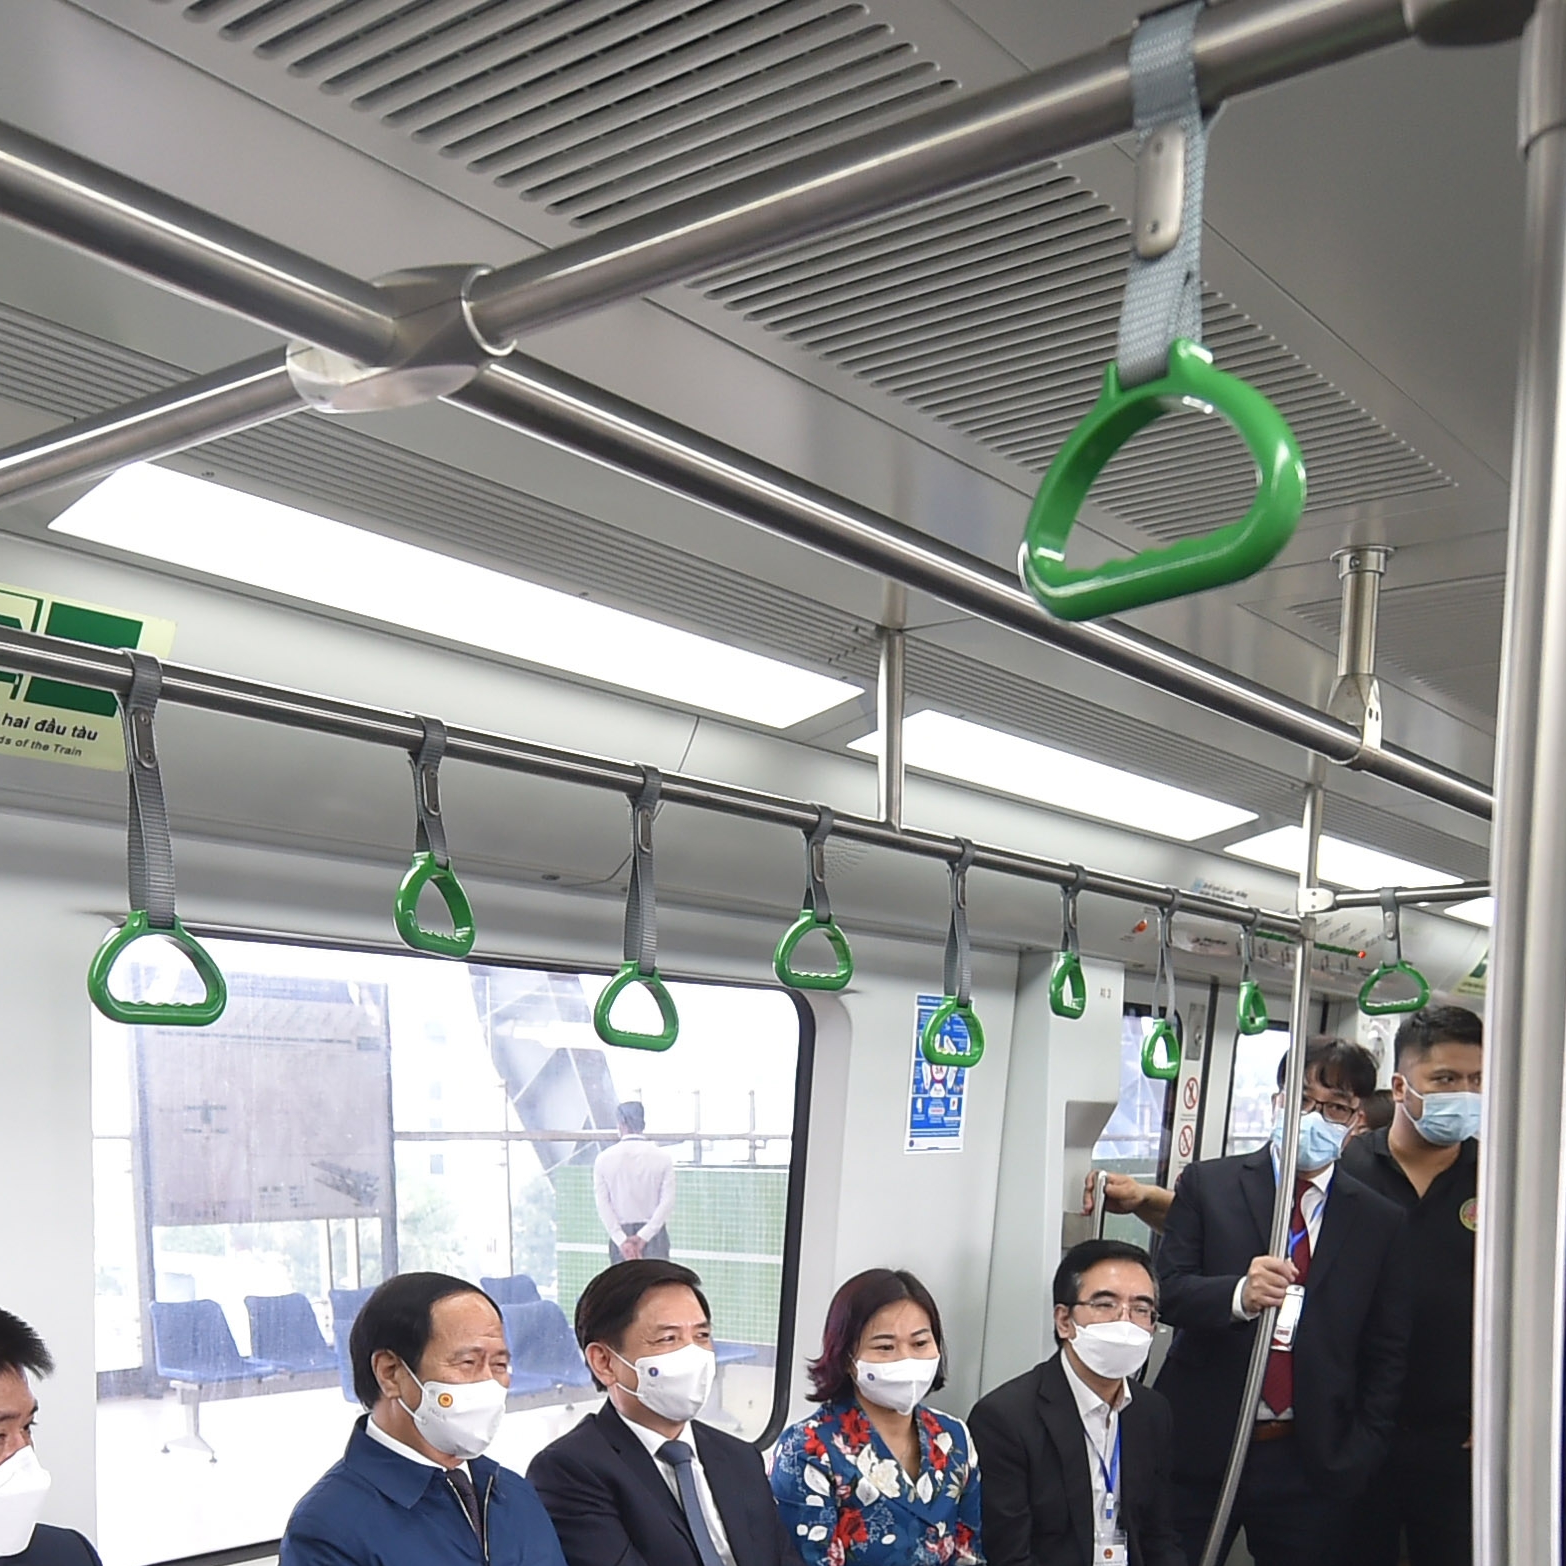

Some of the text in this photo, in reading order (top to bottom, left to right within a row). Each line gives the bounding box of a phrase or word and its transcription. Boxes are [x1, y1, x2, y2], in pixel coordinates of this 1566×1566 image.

[1, 709, 30, 731] hai
[34, 713, 67, 736] đầu
[70, 722, 99, 742] tàu
[15, 738, 30, 750] of
[31, 740, 50, 753] the
[53, 742, 83, 758] Train
